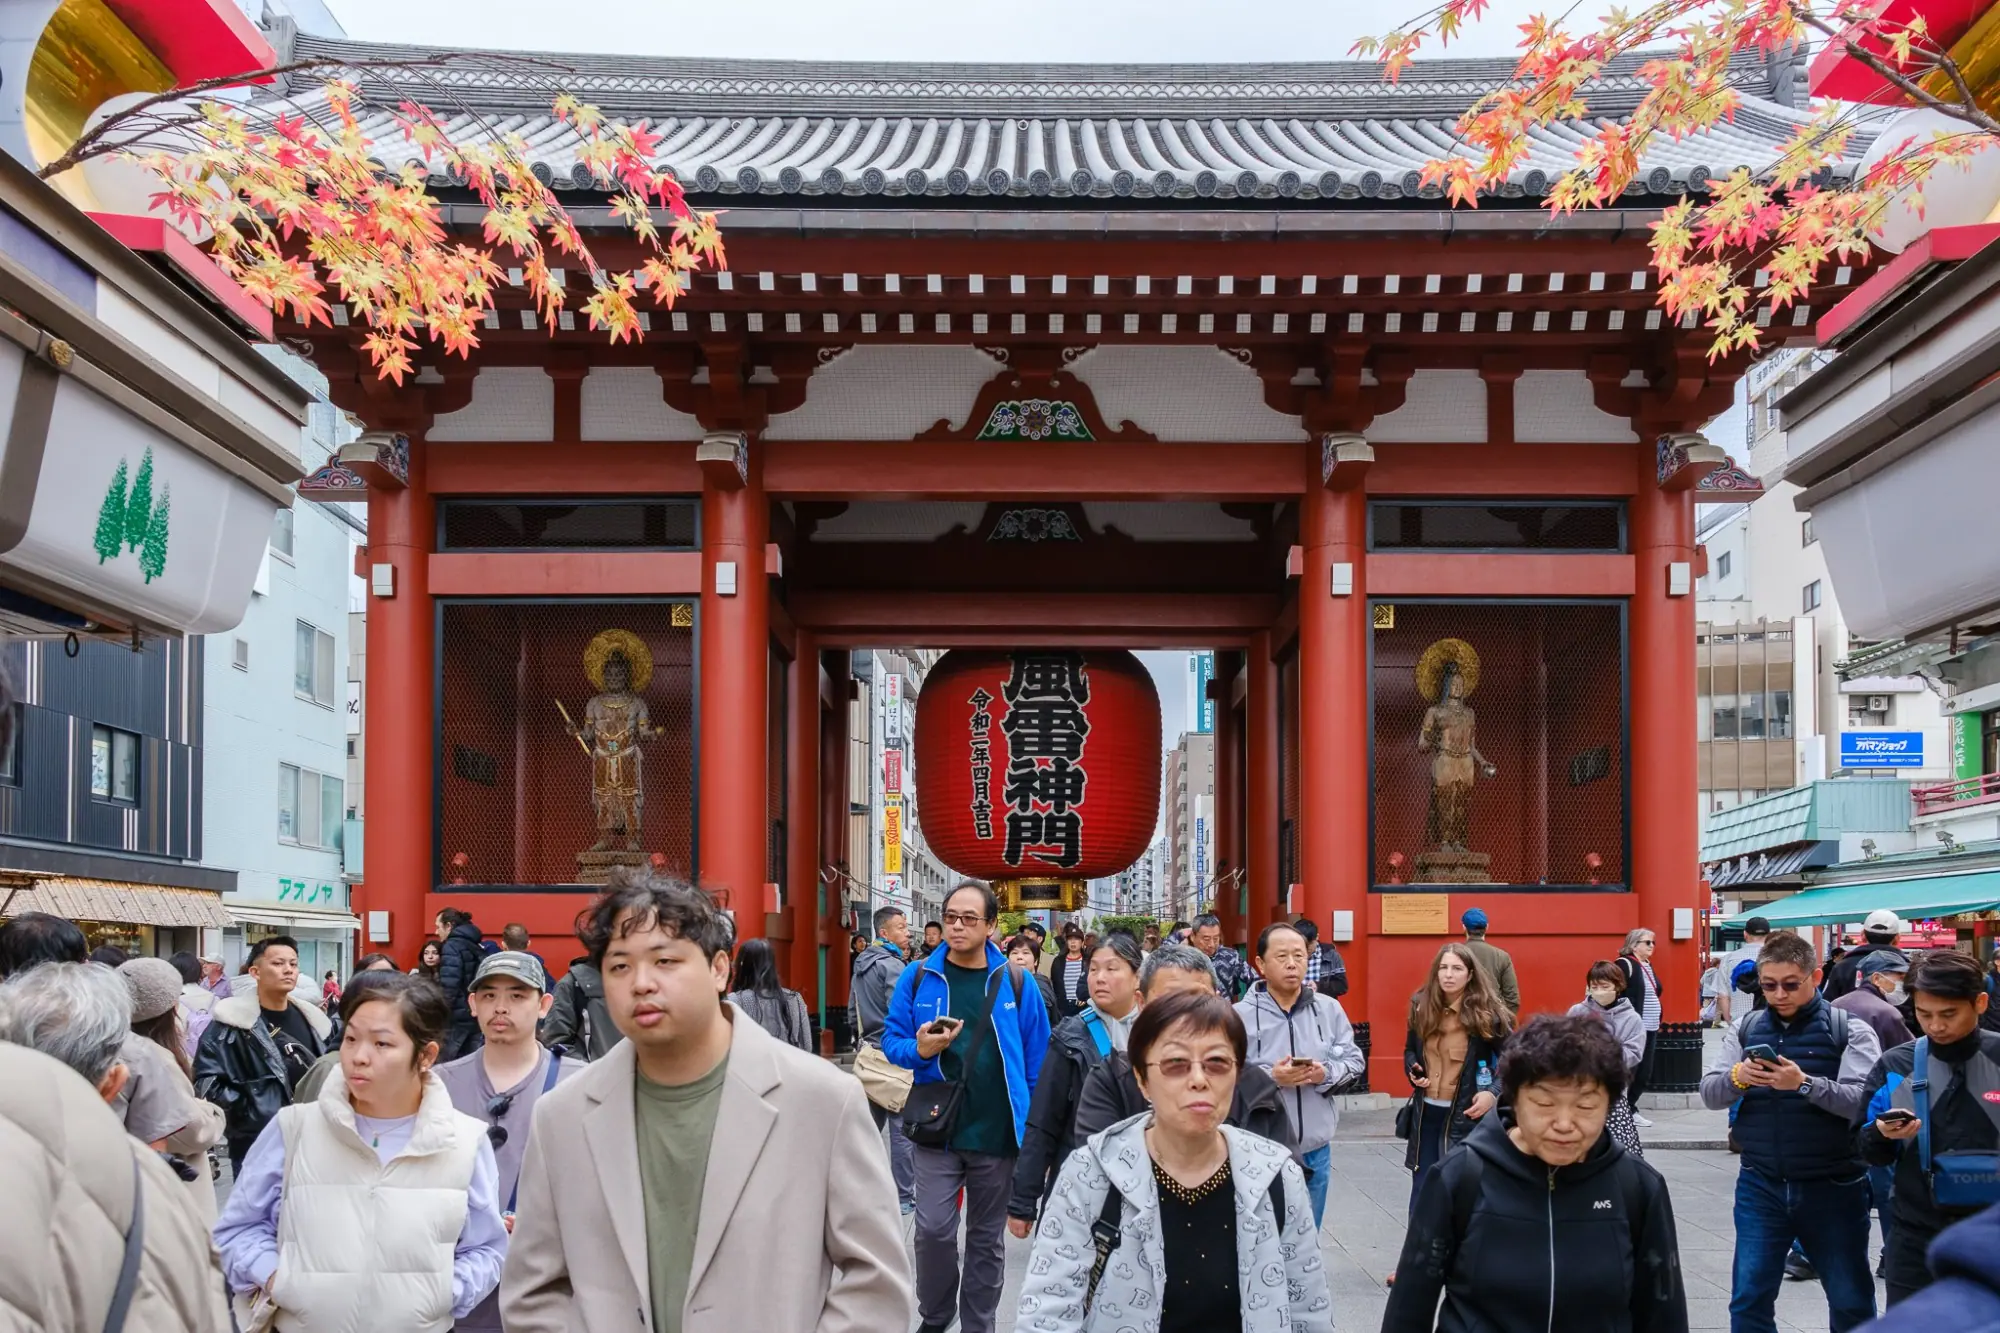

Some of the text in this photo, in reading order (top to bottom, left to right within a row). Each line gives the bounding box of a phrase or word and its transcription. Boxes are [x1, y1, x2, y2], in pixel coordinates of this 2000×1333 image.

[968, 686, 995, 840] 令和二年四月吉日
[1001, 650, 1091, 868] 風雷神門
[1855, 739, 1908, 751] アパマンショップ
[886, 808, 900, 846] Denny's
[278, 878, 334, 905] アオノヤ
